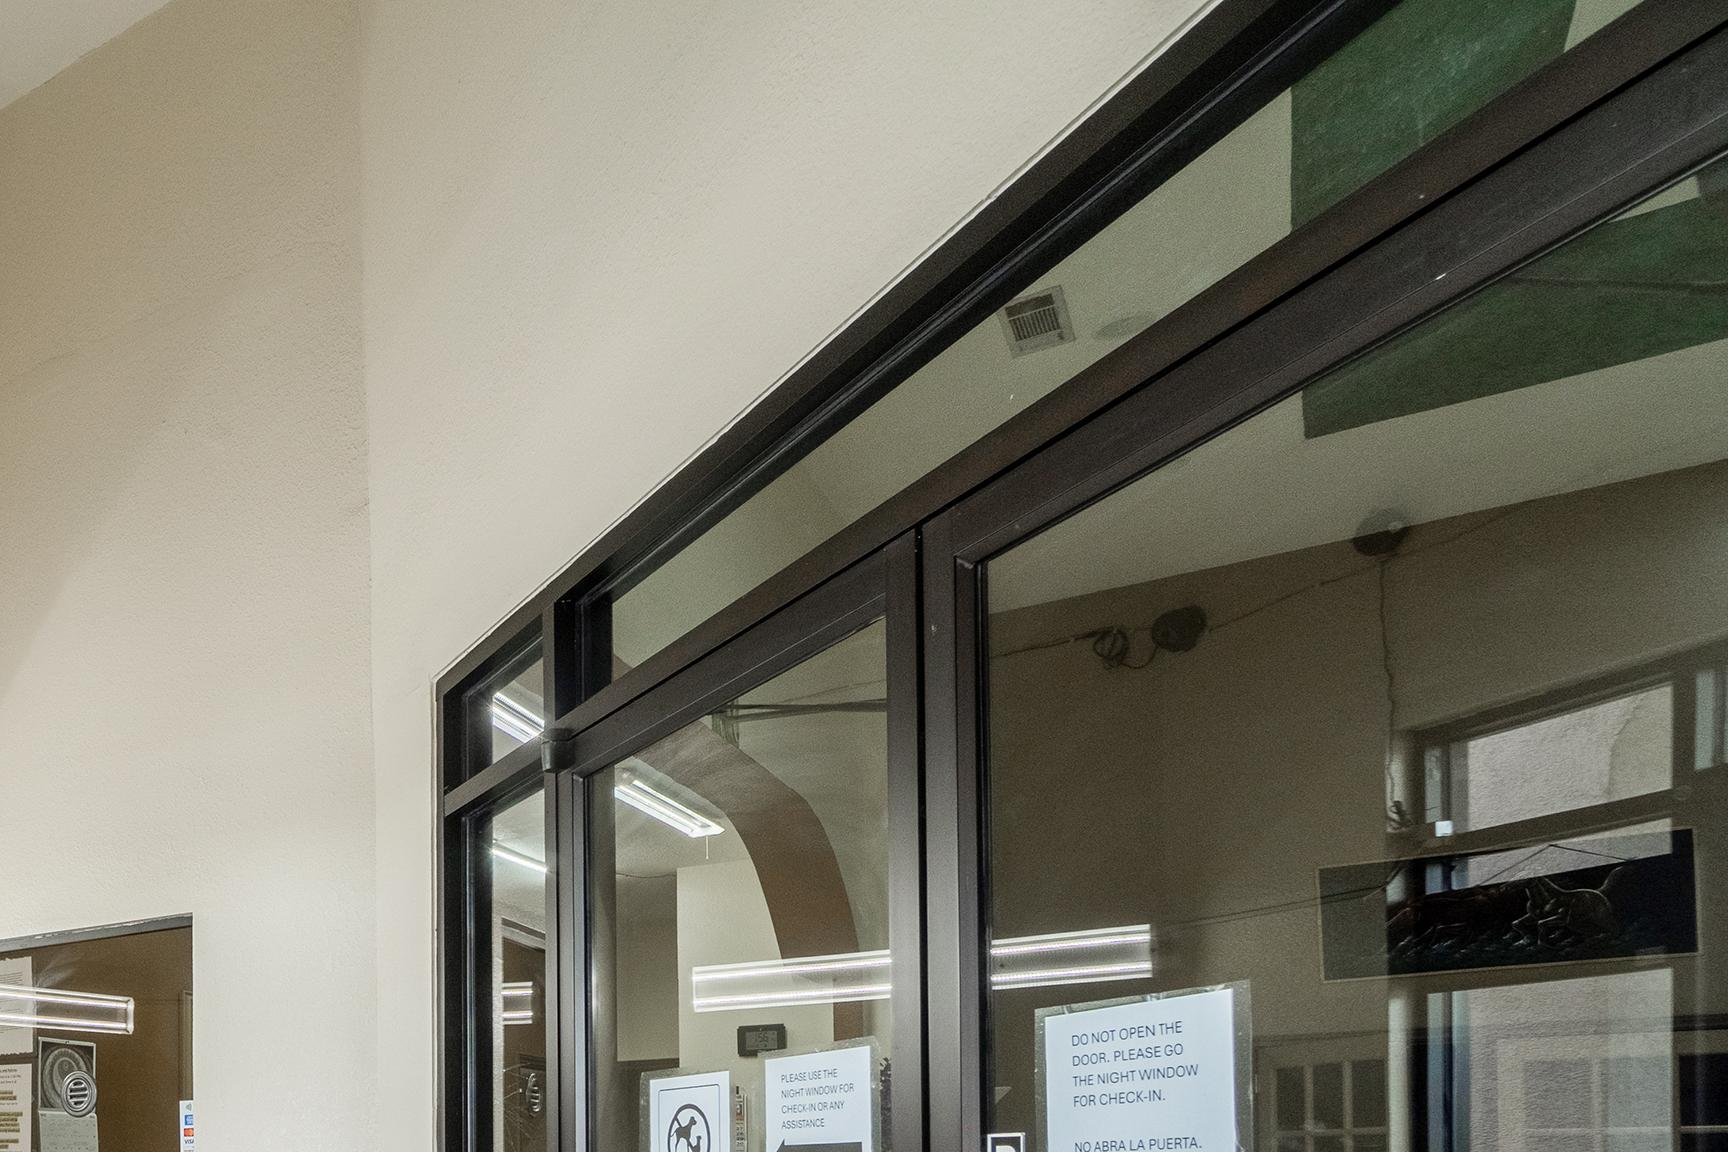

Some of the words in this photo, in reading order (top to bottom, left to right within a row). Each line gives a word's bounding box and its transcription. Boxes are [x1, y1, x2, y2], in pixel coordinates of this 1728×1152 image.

[1072, 1034, 1089, 1046] DO
[1092, 1030, 1115, 1044] NOT
[1119, 1026, 1155, 1040] OPEN
[1158, 1021, 1182, 1035] THE
[1072, 1053, 1109, 1066] DOOR.
[1114, 1046, 1161, 1063] PLEASE
[1164, 1043, 1183, 1056] GO
[781, 1072, 806, 1082] PLEASE
[808, 1070, 822, 1080] USE
[824, 1069, 838, 1078] THE
[1073, 1074, 1094, 1087] THE
[1097, 1070, 1135, 1085] NIGHT
[1138, 1064, 1198, 1081] WINDOW
[781, 1088, 804, 1098] NIGHT
[806, 1084, 837, 1096] WINDOW
[839, 1082, 854, 1093] FOR
[1074, 1094, 1096, 1107] FOR
[1100, 1089, 1165, 1105] CHECK-IN.
[782, 1103, 816, 1114] CHECK-IN
[818, 1102, 828, 1112] OR
[828, 1100, 844, 1110] ANY
[782, 1118, 824, 1129] ASSISTANCE
[1075, 1141, 1092, 1152] NO
[1095, 1140, 1125, 1151] ABRA
[1130, 1139, 1145, 1151] LA
[1149, 1137, 1202, 1150] PUERTA.
